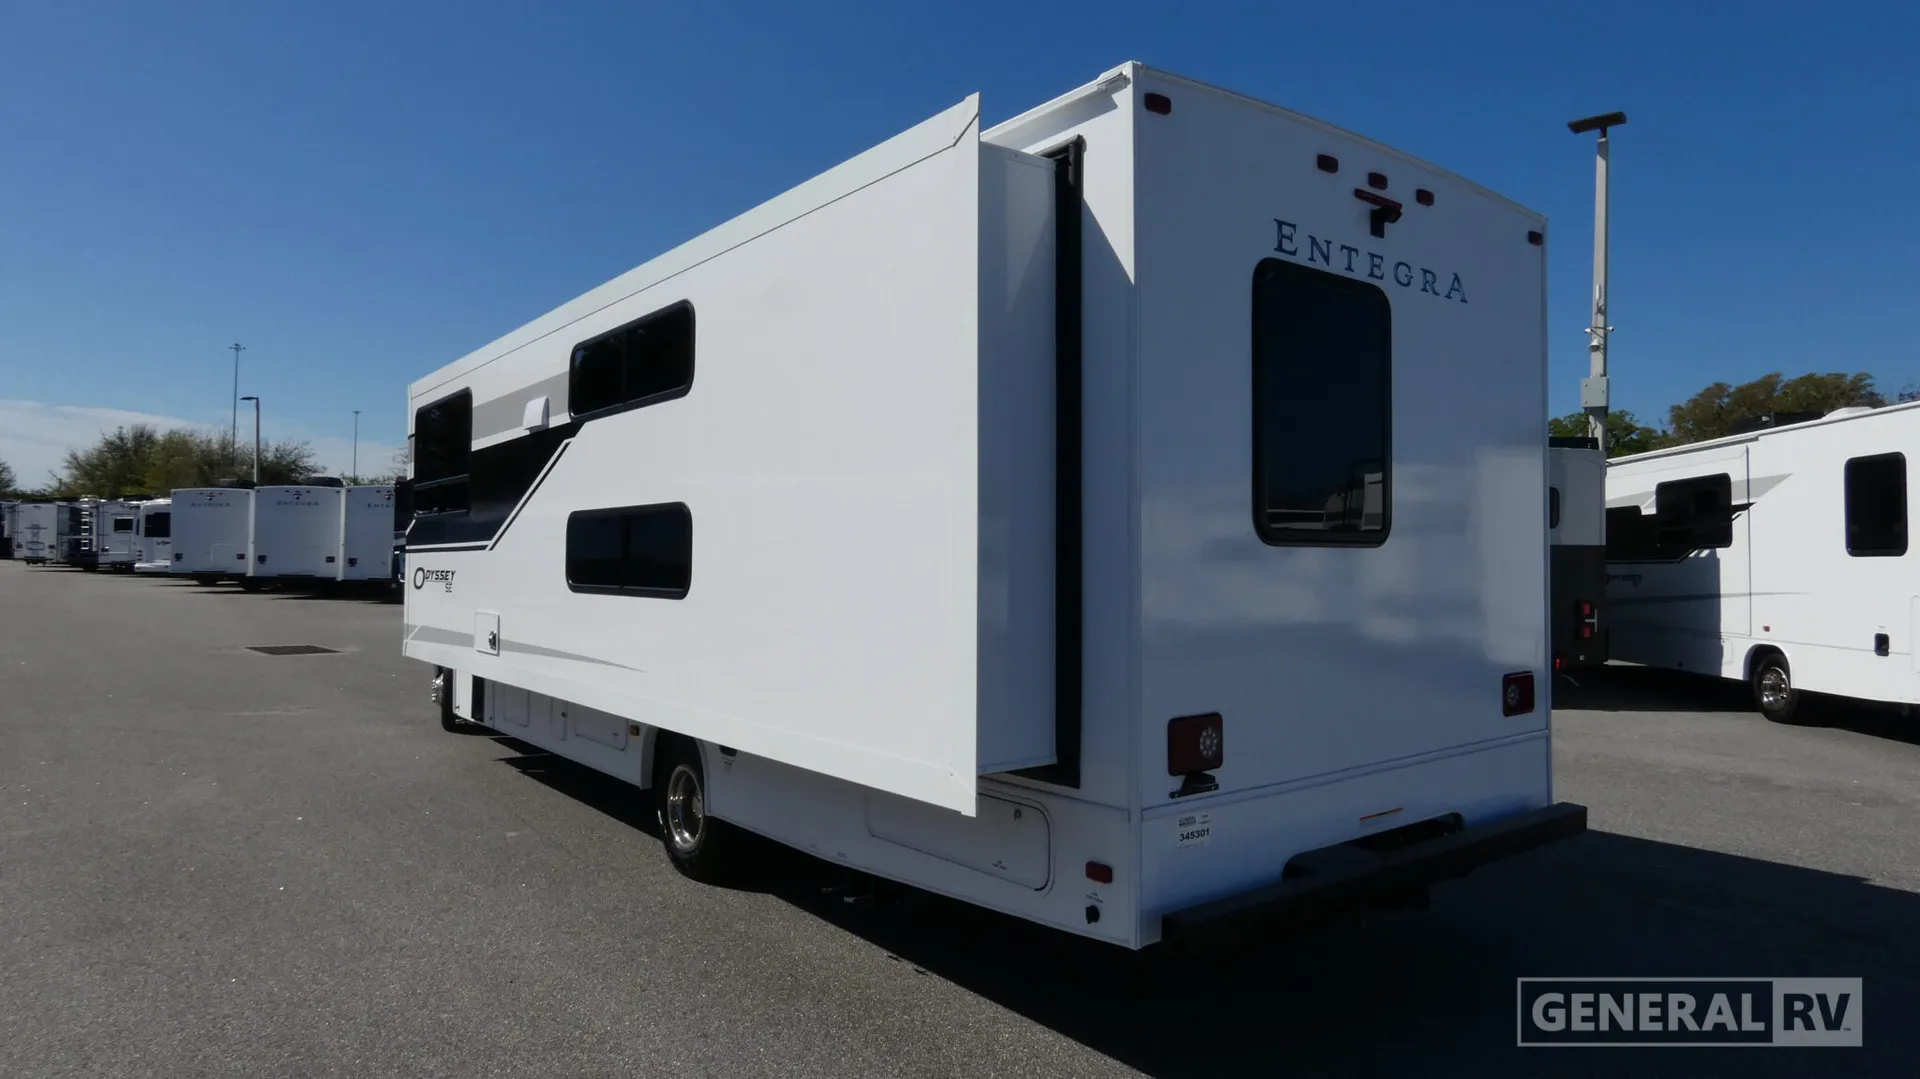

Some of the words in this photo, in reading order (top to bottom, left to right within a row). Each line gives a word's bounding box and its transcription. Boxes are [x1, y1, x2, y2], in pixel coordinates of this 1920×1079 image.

[1273, 218, 1468, 304] ENTEGRA
[414, 567, 456, 590] ODYSSEY
[1179, 828, 1210, 842] 345301
